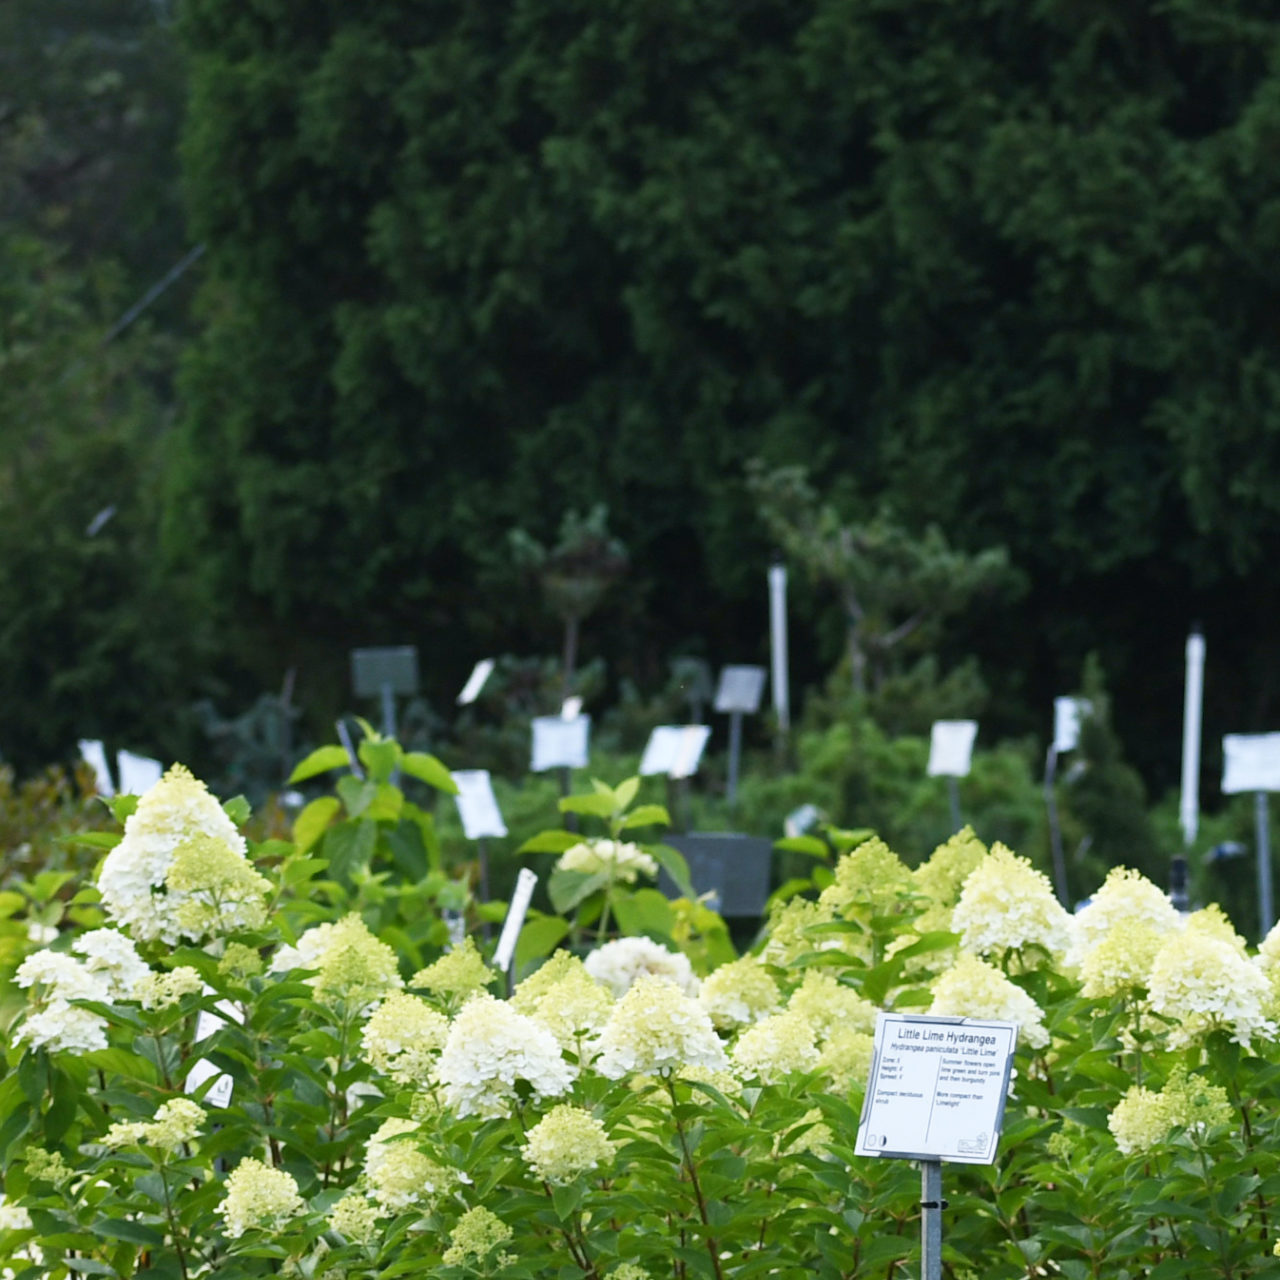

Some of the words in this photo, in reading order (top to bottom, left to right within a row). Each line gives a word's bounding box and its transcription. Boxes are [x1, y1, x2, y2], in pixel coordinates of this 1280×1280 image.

[898, 1028, 920, 1040] Little
[922, 1029, 944, 1041] Lime
[946, 1031, 997, 1047] Hydrangea
[890, 1043, 924, 1053] Hydrangea
